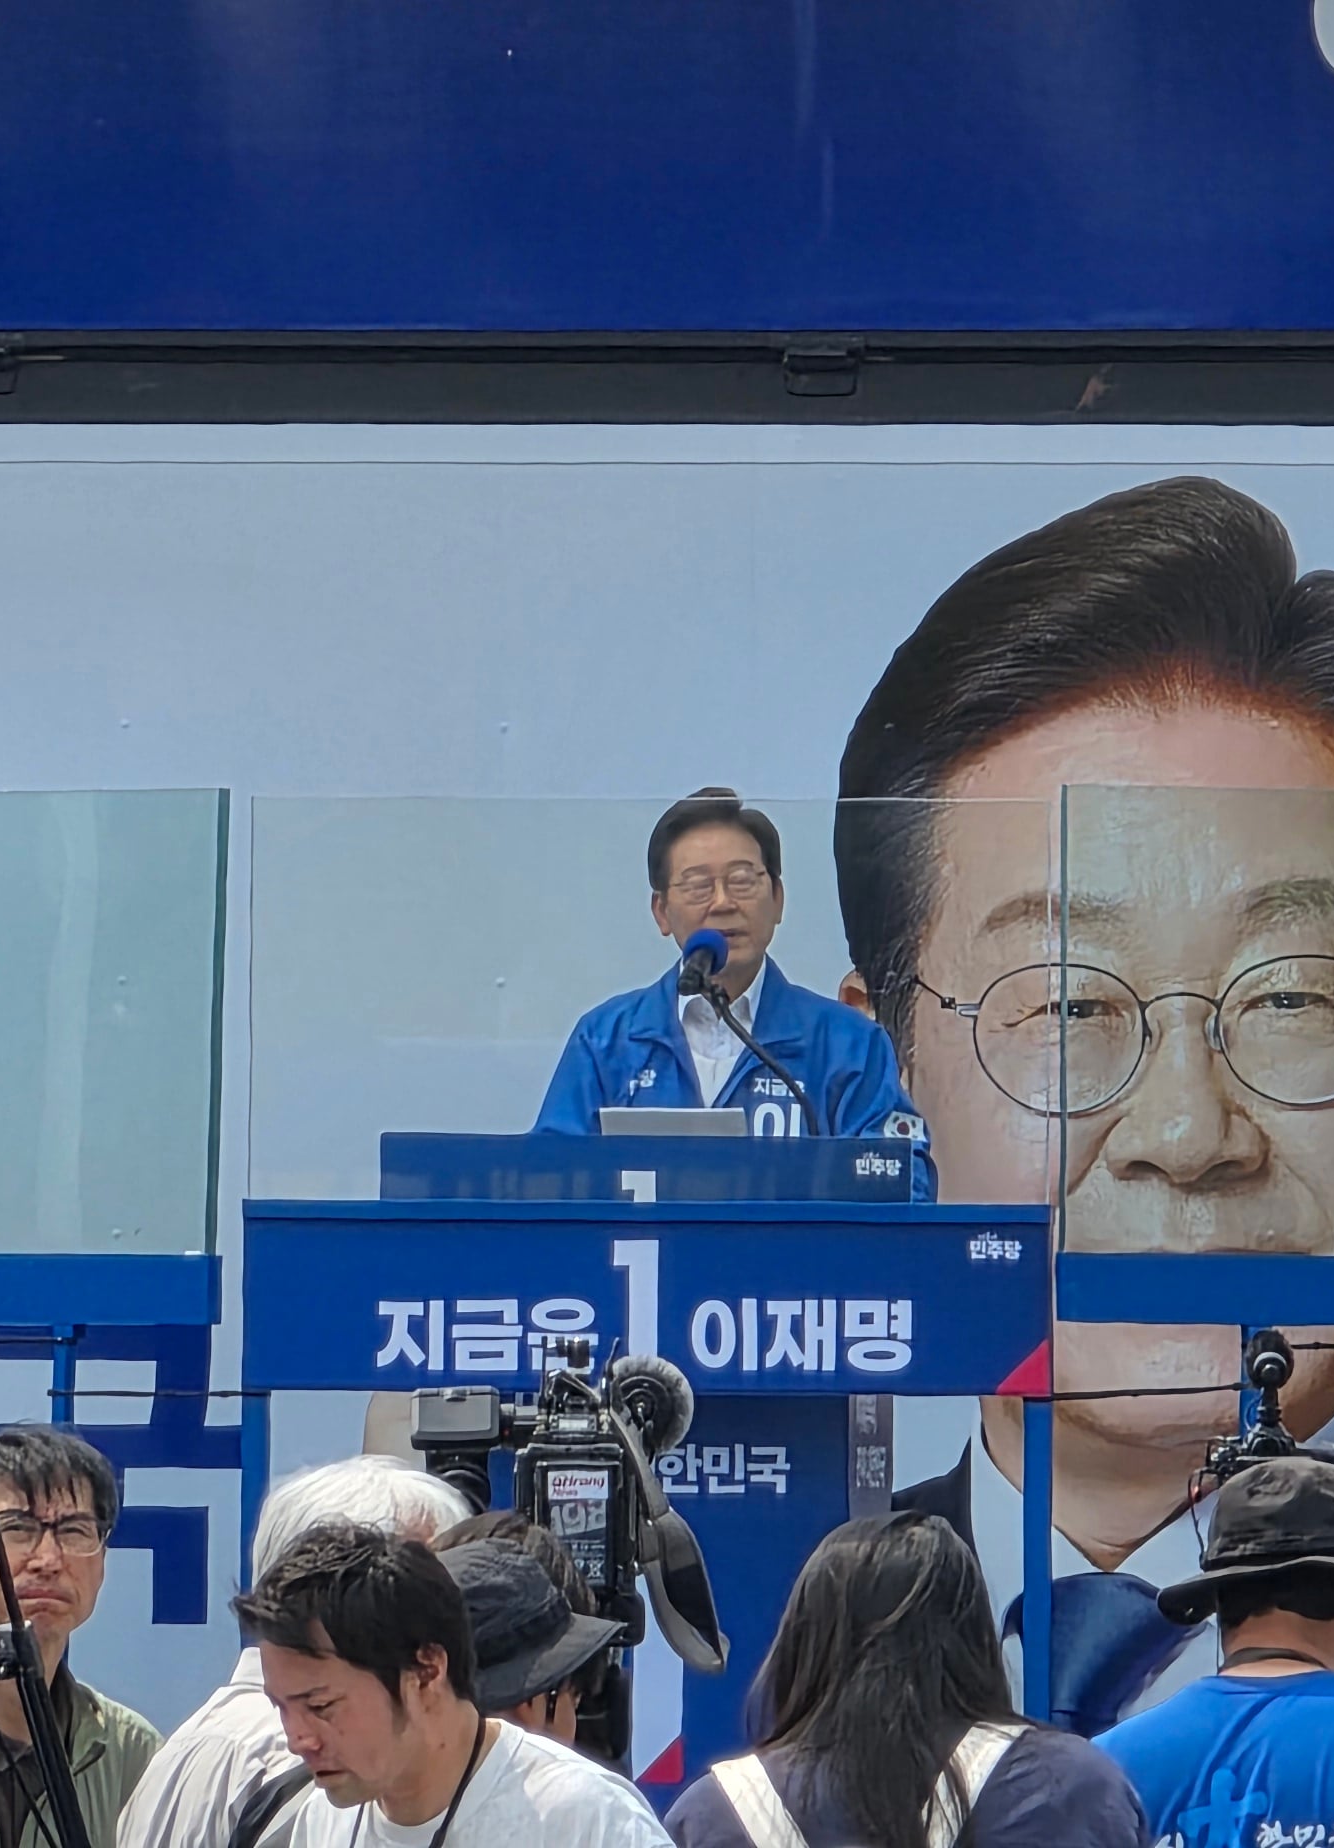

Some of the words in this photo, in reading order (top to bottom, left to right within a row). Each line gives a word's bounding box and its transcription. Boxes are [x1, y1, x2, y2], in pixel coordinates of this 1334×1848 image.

[969, 1239, 1022, 1261] 민주당
[376, 1299, 599, 1373] 지금은
[691, 1299, 913, 1372] 이재명
[651, 1443, 791, 1494] 한민국
